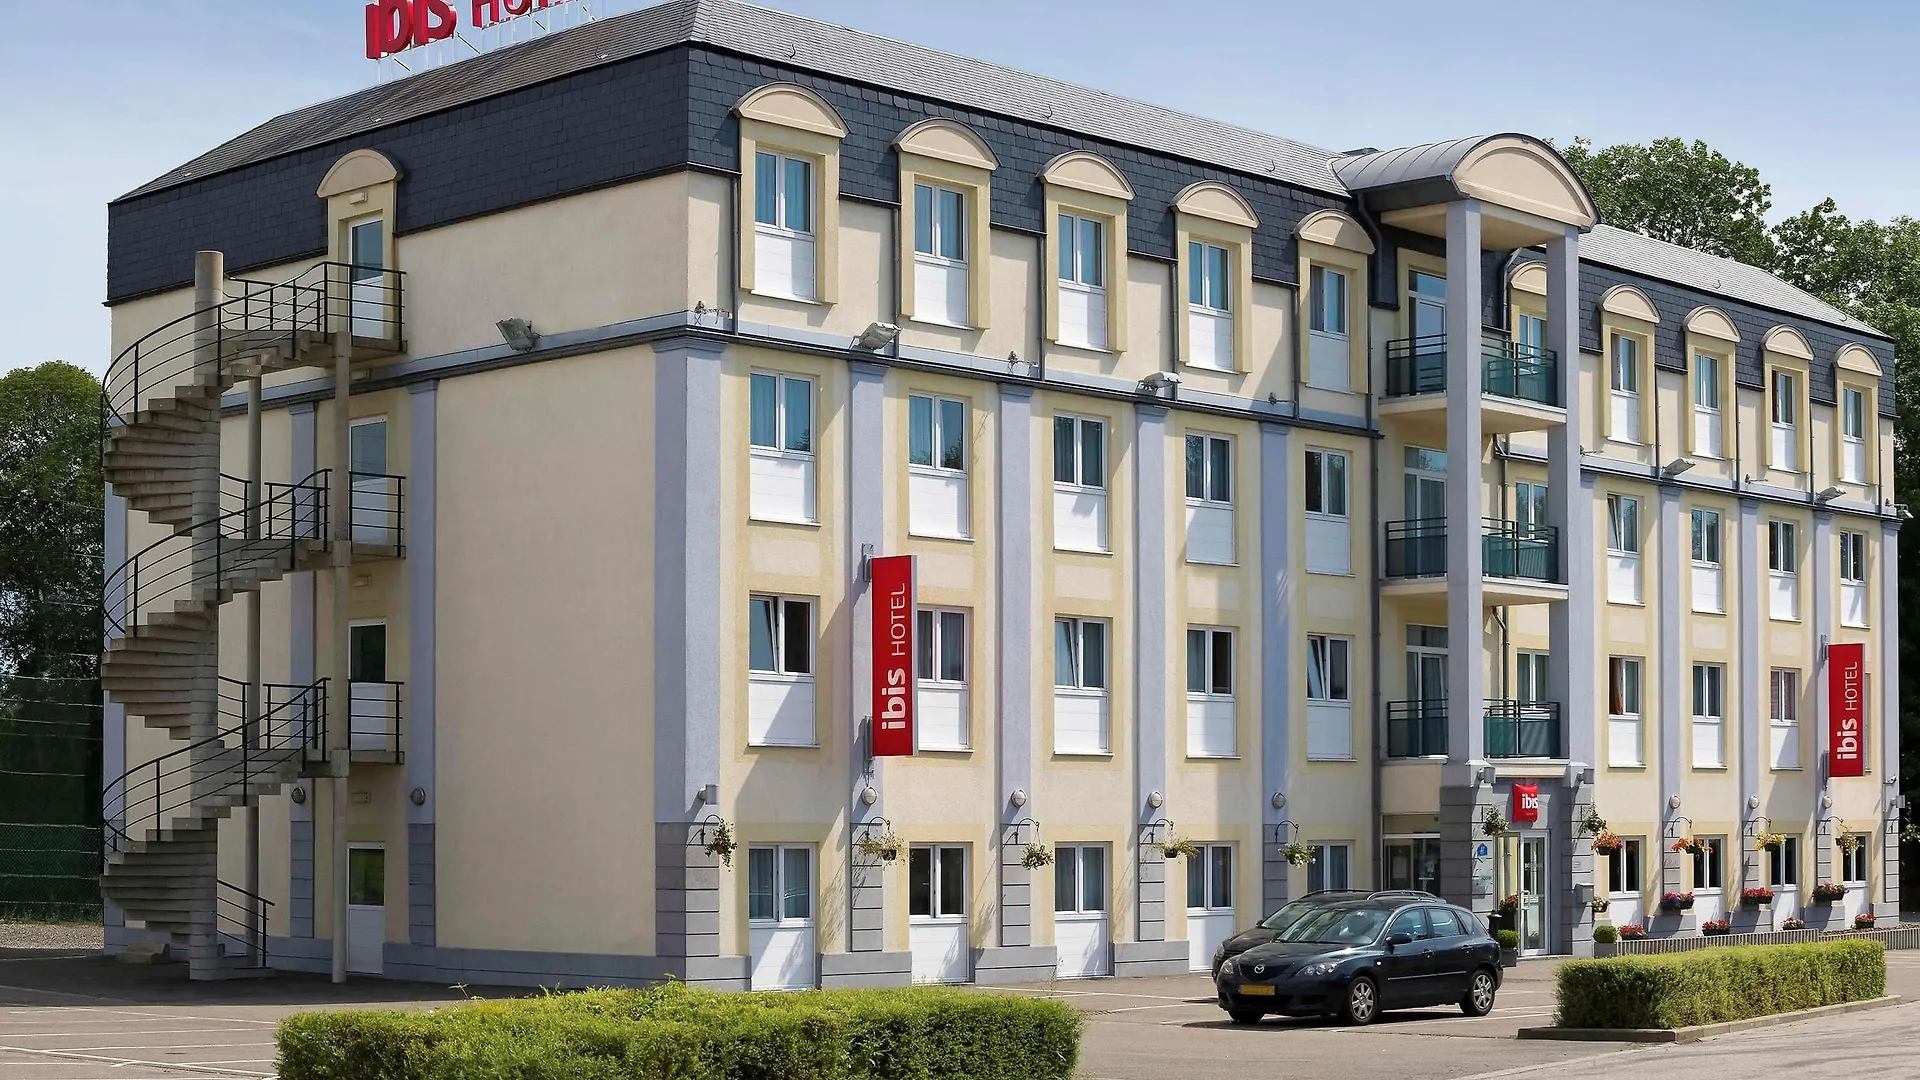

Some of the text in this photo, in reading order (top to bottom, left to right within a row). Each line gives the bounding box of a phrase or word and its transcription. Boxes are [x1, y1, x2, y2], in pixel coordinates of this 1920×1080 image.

[882, 583, 906, 730] ibis HOTEL
[1837, 661, 1858, 760] ibis HOTEL
[1521, 793, 1539, 809] ibis
